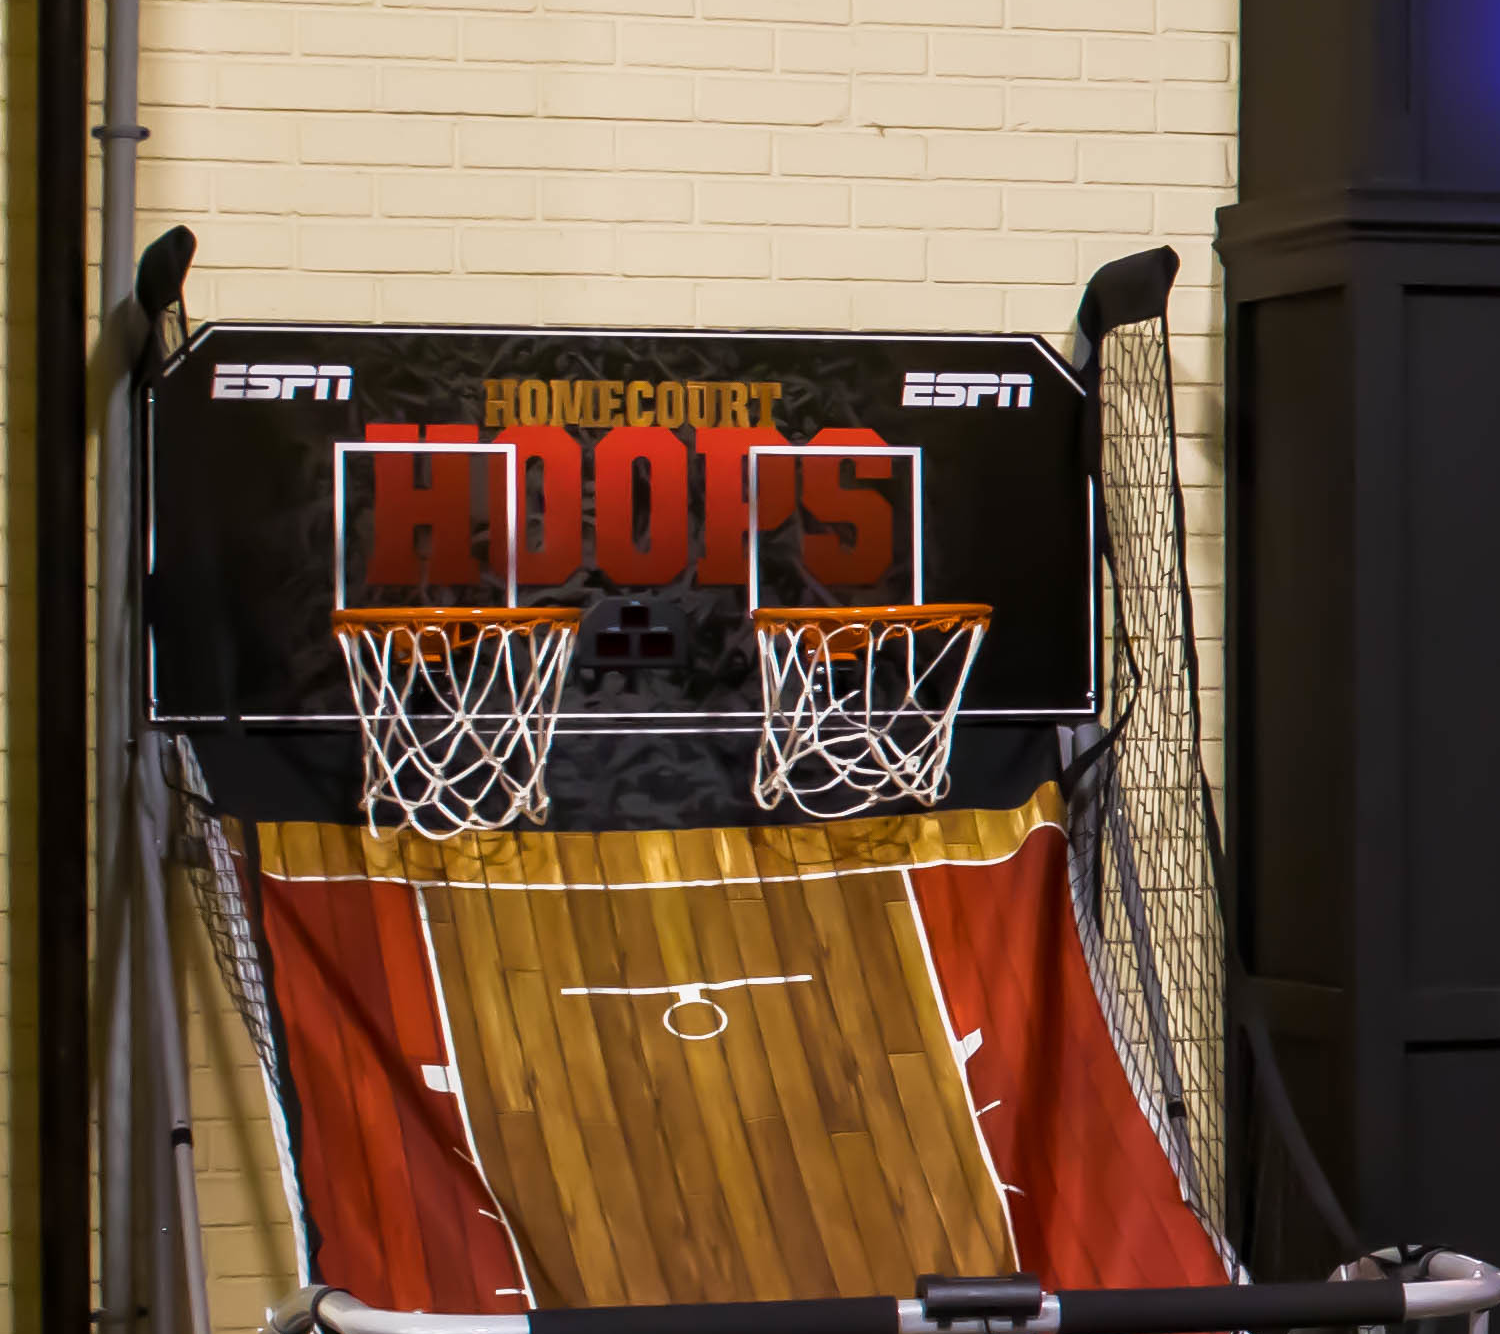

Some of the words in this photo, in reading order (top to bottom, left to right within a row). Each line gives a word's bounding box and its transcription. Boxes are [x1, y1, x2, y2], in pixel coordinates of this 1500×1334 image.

[211, 364, 353, 400] ESPN
[483, 378, 783, 430] HOMECOURT
[902, 372, 1033, 408] ESPN
[366, 424, 895, 586] HOOPS
